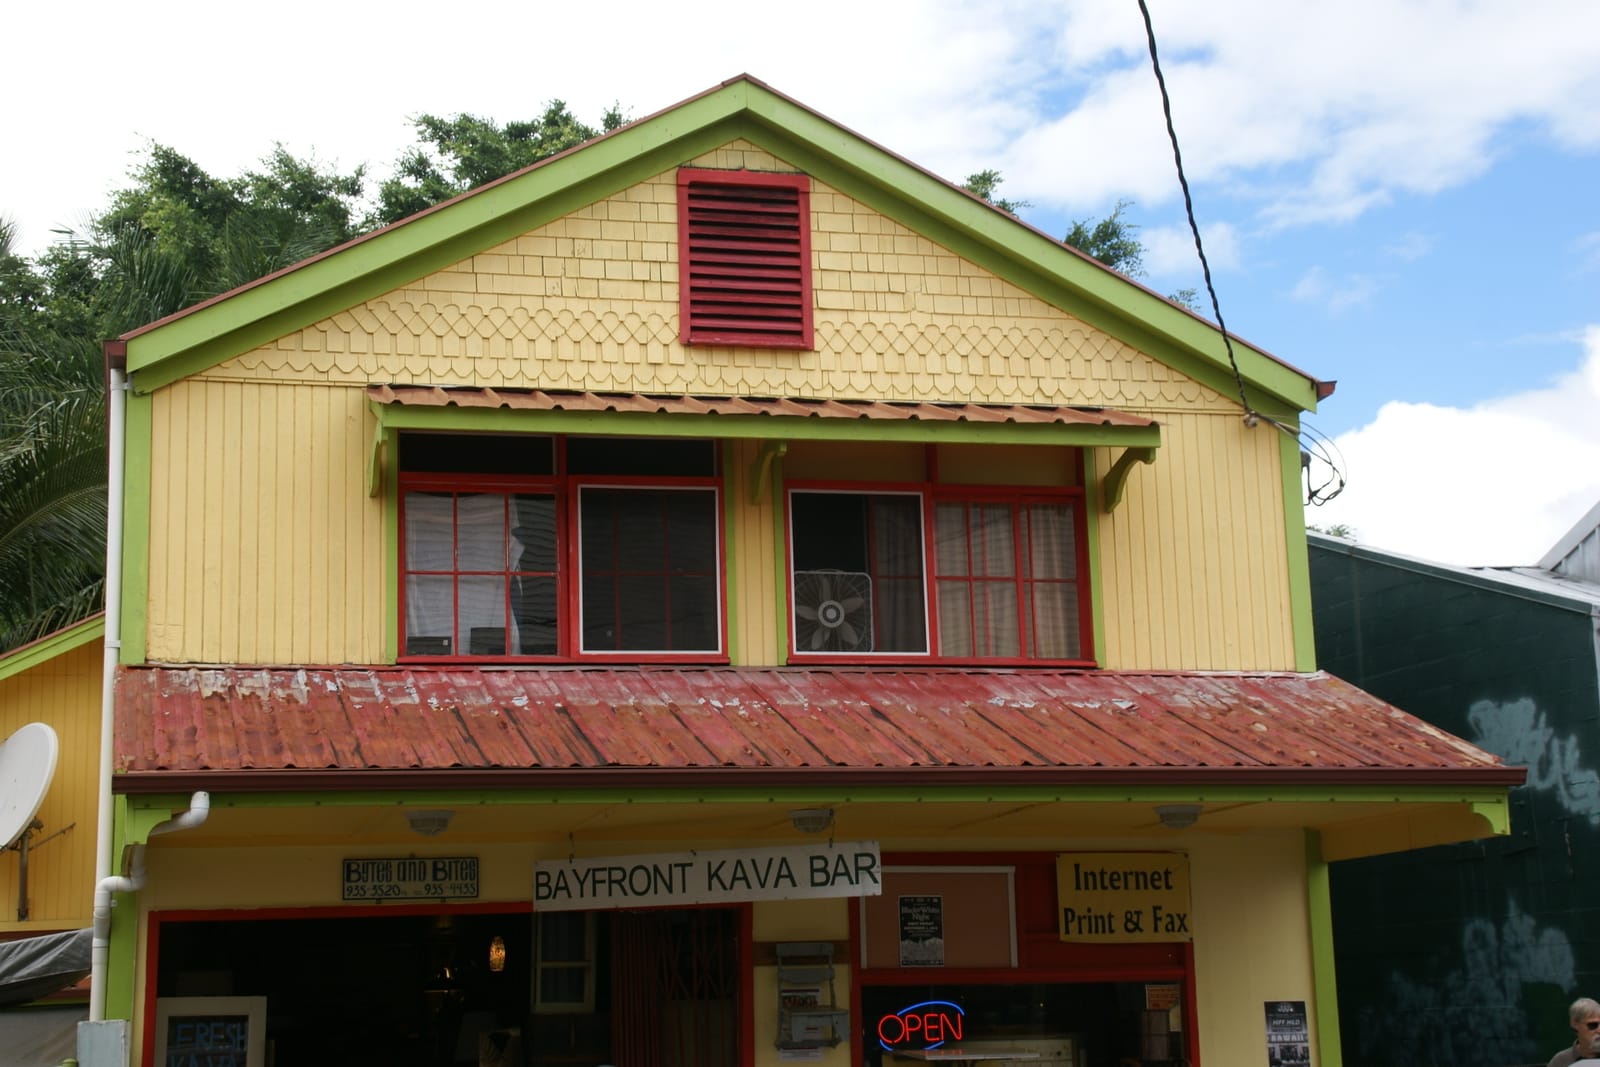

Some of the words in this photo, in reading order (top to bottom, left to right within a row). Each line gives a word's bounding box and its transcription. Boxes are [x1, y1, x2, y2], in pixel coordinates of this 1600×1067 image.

[535, 862, 693, 901] BAYFRONT
[707, 856, 798, 891] KAVA
[809, 852, 880, 888] BAR
[1073, 863, 1173, 891] Internet
[1063, 907, 1116, 935] Print
[1123, 910, 1145, 933] &
[1152, 905, 1189, 933] Fax
[176, 1022, 249, 1052] FRESH
[877, 1012, 963, 1044] OPEN
